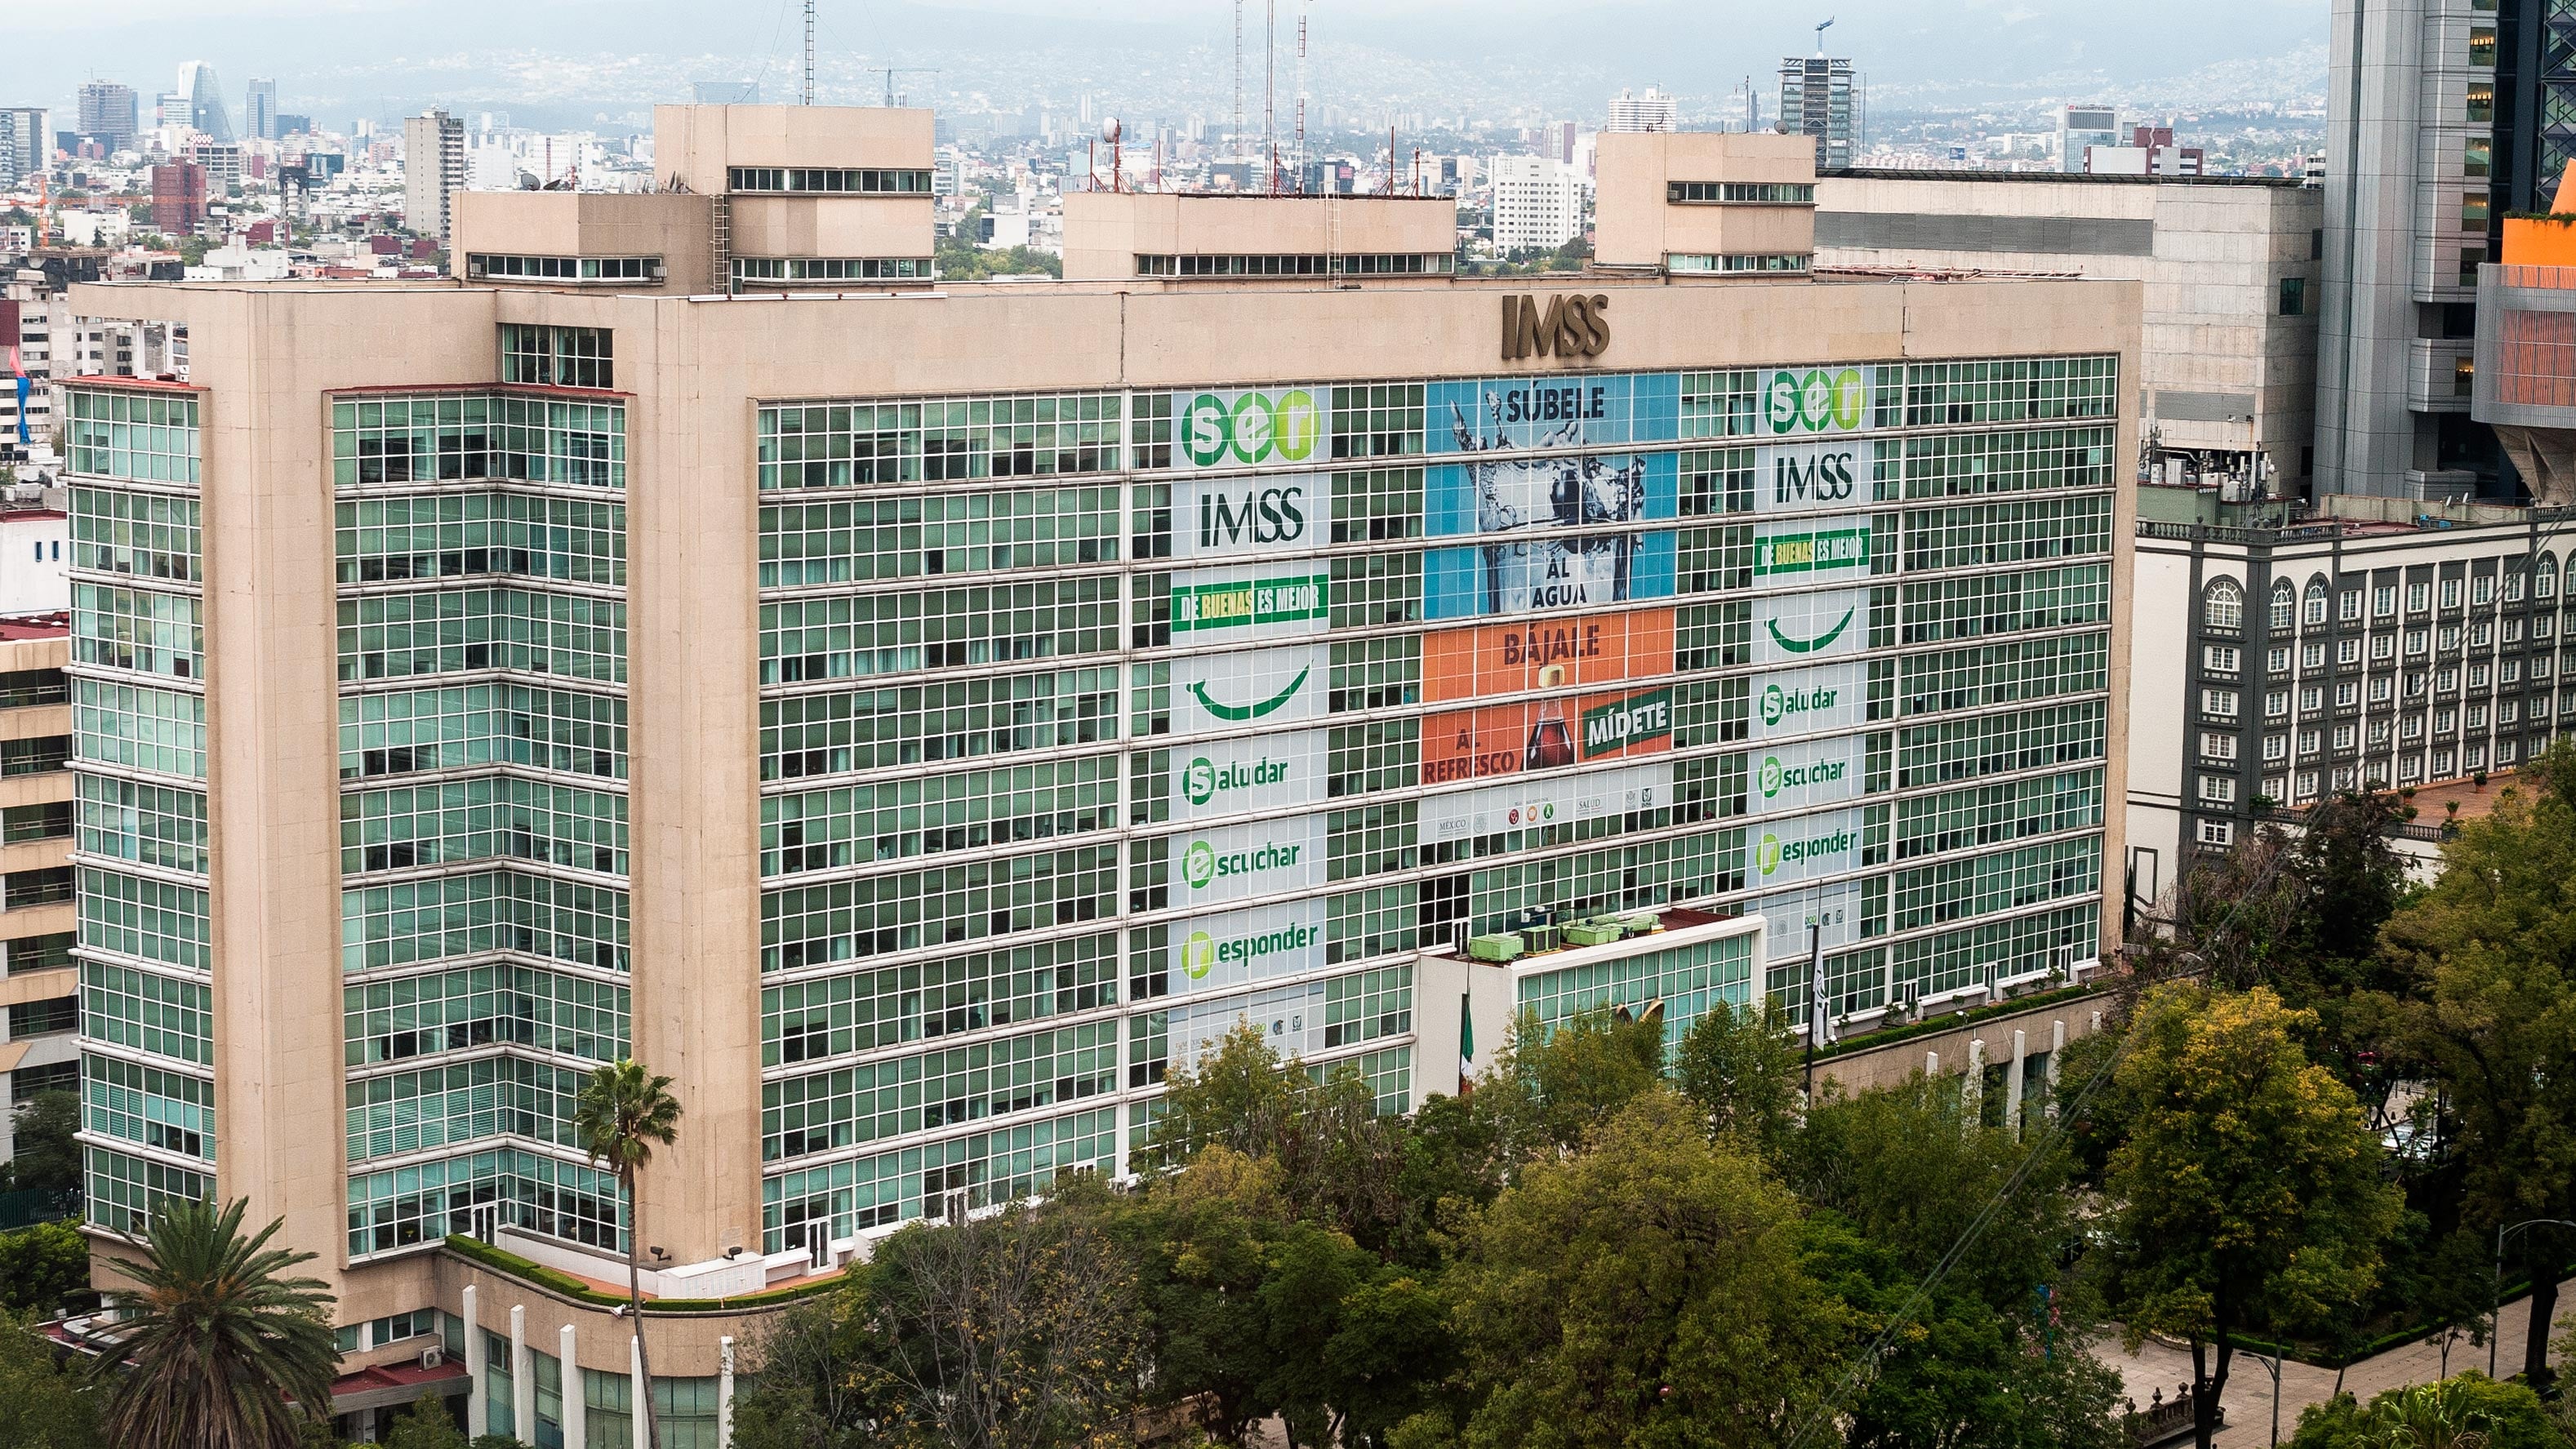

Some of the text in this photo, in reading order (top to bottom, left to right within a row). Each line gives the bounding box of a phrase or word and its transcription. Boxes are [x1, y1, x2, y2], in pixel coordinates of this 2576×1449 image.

[1502, 294, 1610, 358] IMSS
[1506, 380, 1604, 422] SÚBELE
[1767, 372, 1864, 429] ser
[1185, 397, 1317, 462] ser
[1777, 452, 1853, 503] IMSS
[1201, 487, 1303, 548] IMSS
[1546, 557, 1570, 579] AL
[1761, 536, 1863, 567] DE BUENAS ES MEJOR
[1181, 584, 1319, 621] DE BUENAS ES MEJOR
[1532, 583, 1587, 608] AGUA
[1504, 623, 1599, 666] BÁJALE
[1456, 727, 1481, 749] AL
[1588, 700, 1666, 747] MÍDETE
[1423, 751, 1515, 785] REFRESCO
